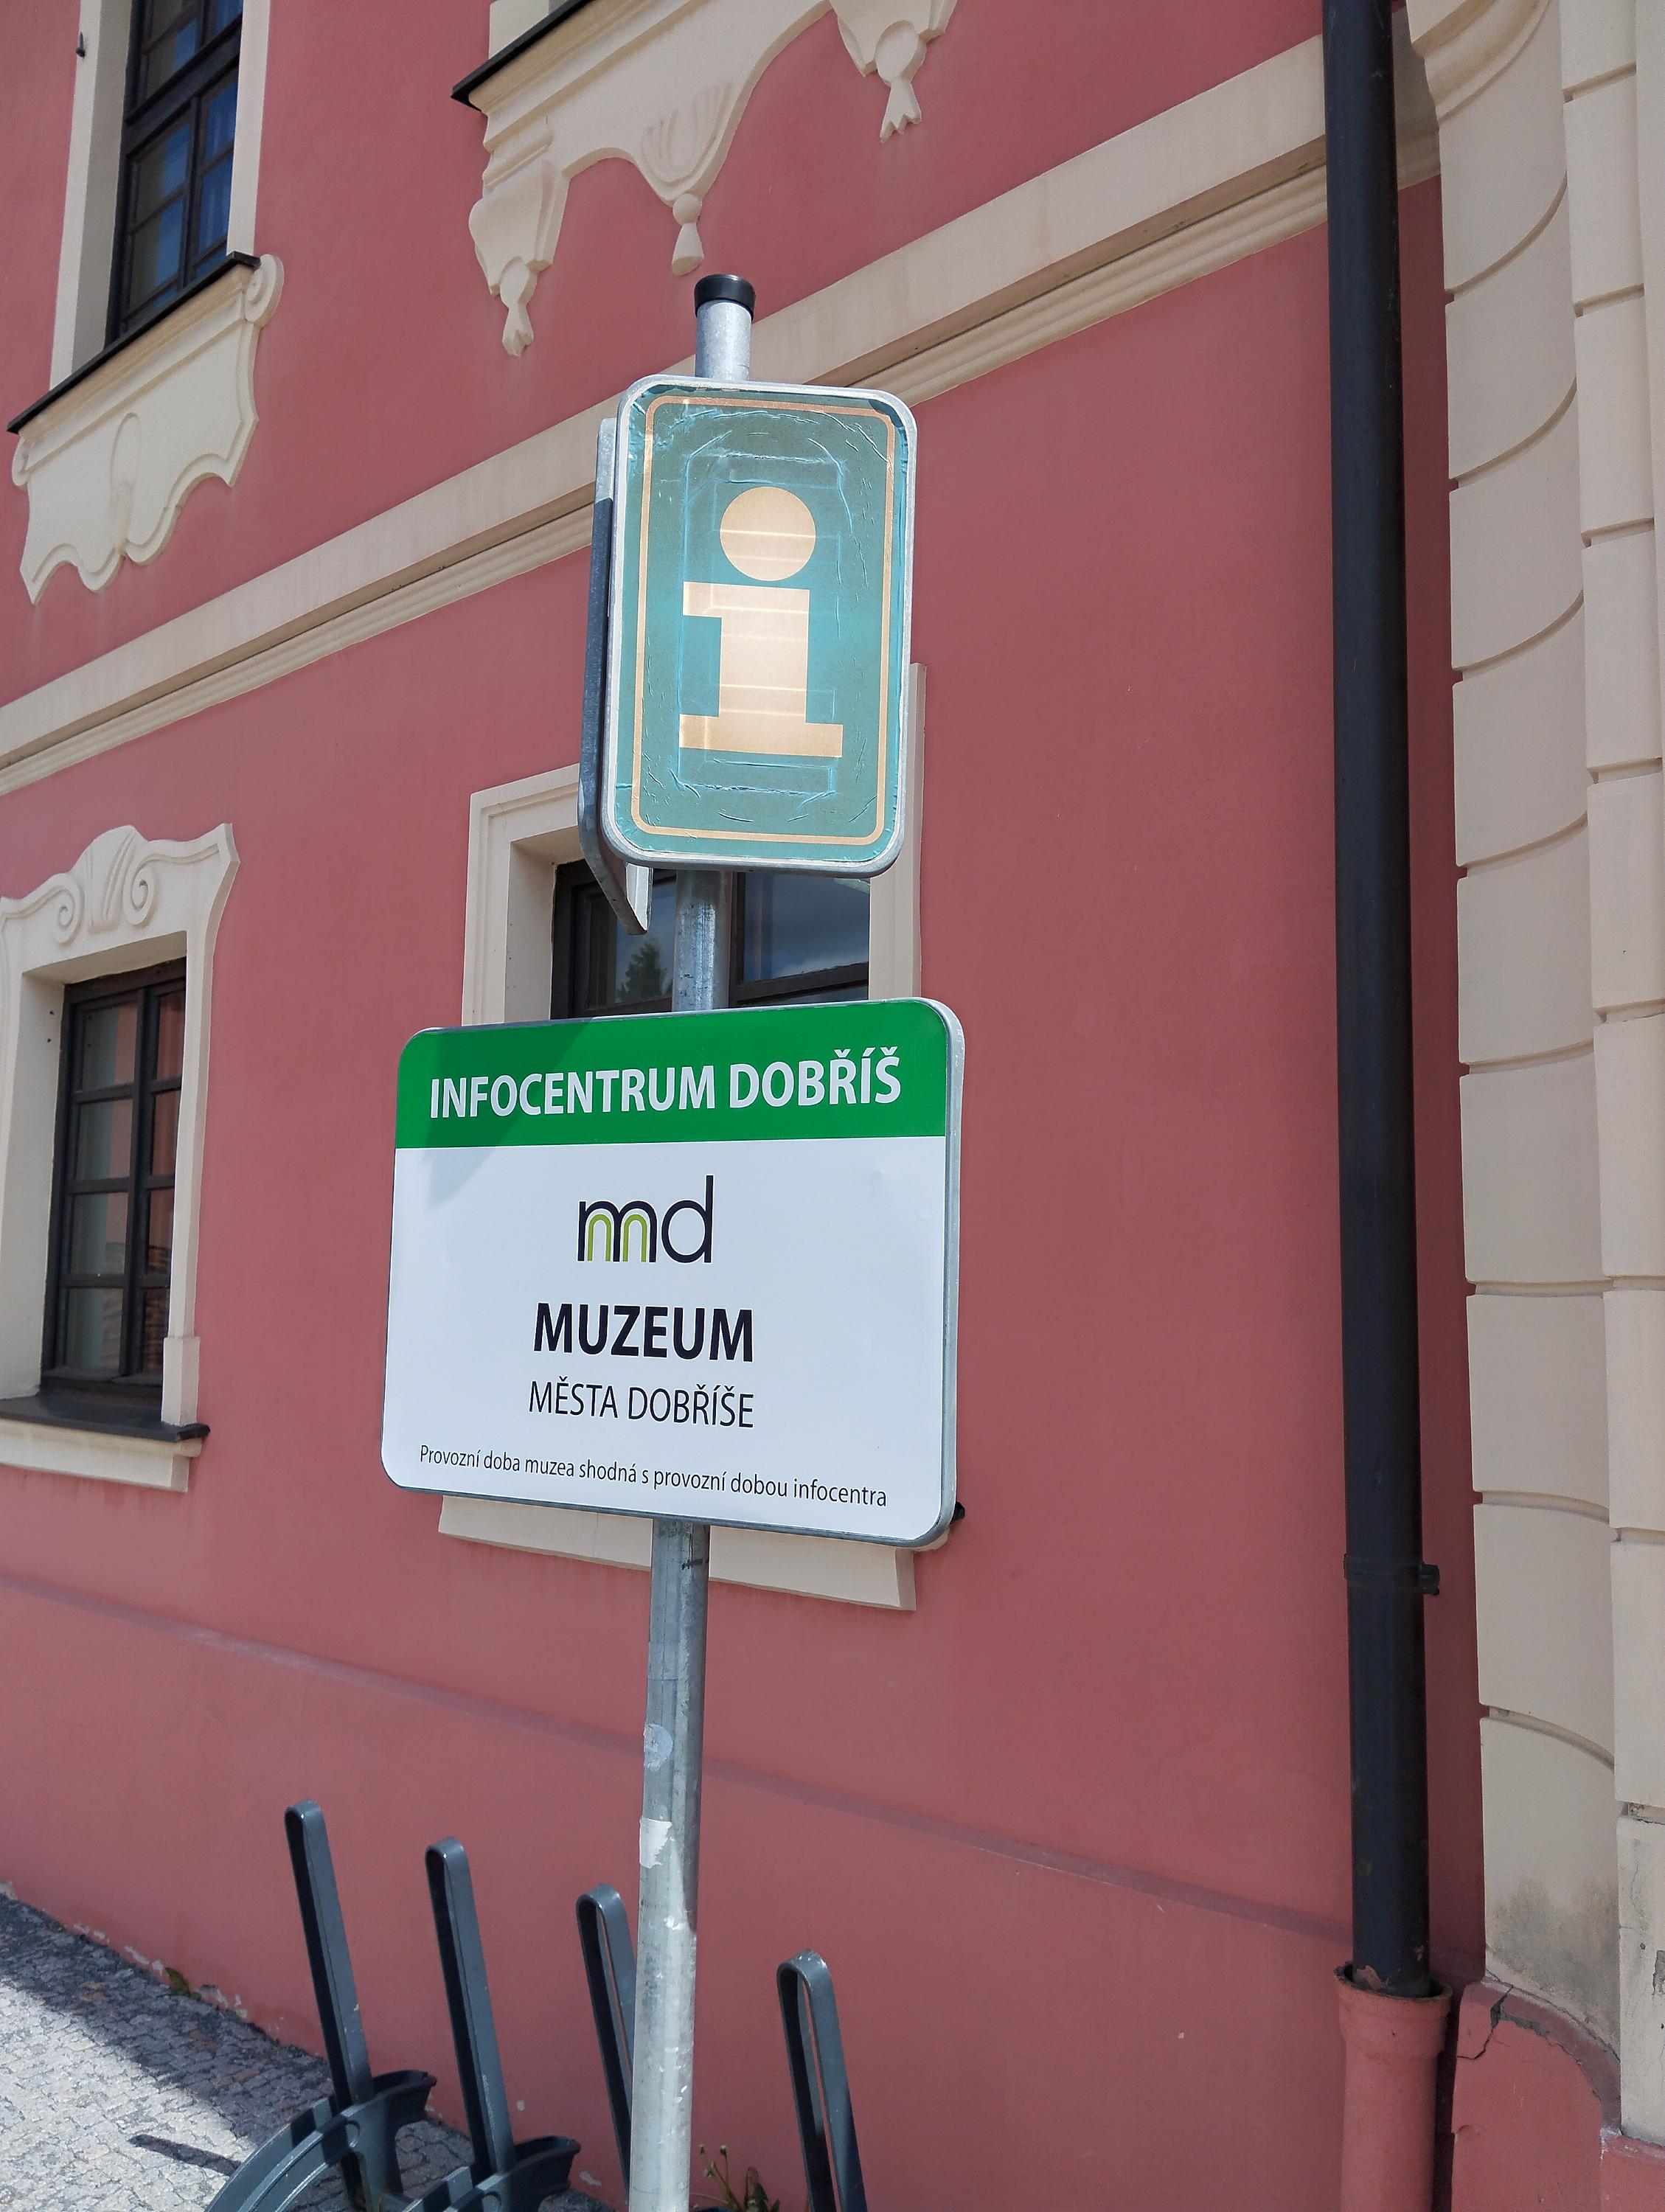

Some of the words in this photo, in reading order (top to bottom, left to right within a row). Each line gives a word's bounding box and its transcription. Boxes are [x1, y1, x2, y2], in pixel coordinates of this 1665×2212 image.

[430, 1065, 715, 1119] INFOCENTRUM
[729, 1046, 901, 1108] DOBŘÍŠ
[533, 1303, 753, 1362] MUZEUM
[529, 1376, 619, 1419] MĚSTA
[628, 1384, 754, 1428] DOBŘÍŠE
[420, 1444, 482, 1468] Provozní
[483, 1450, 521, 1472] doba
[524, 1458, 574, 1477] muzea
[579, 1458, 636, 1483] shodná
[642, 1469, 649, 1484] s
[653, 1470, 727, 1491] provozní
[730, 1472, 788, 1498] dobou
[793, 1478, 887, 1506] infocentra
